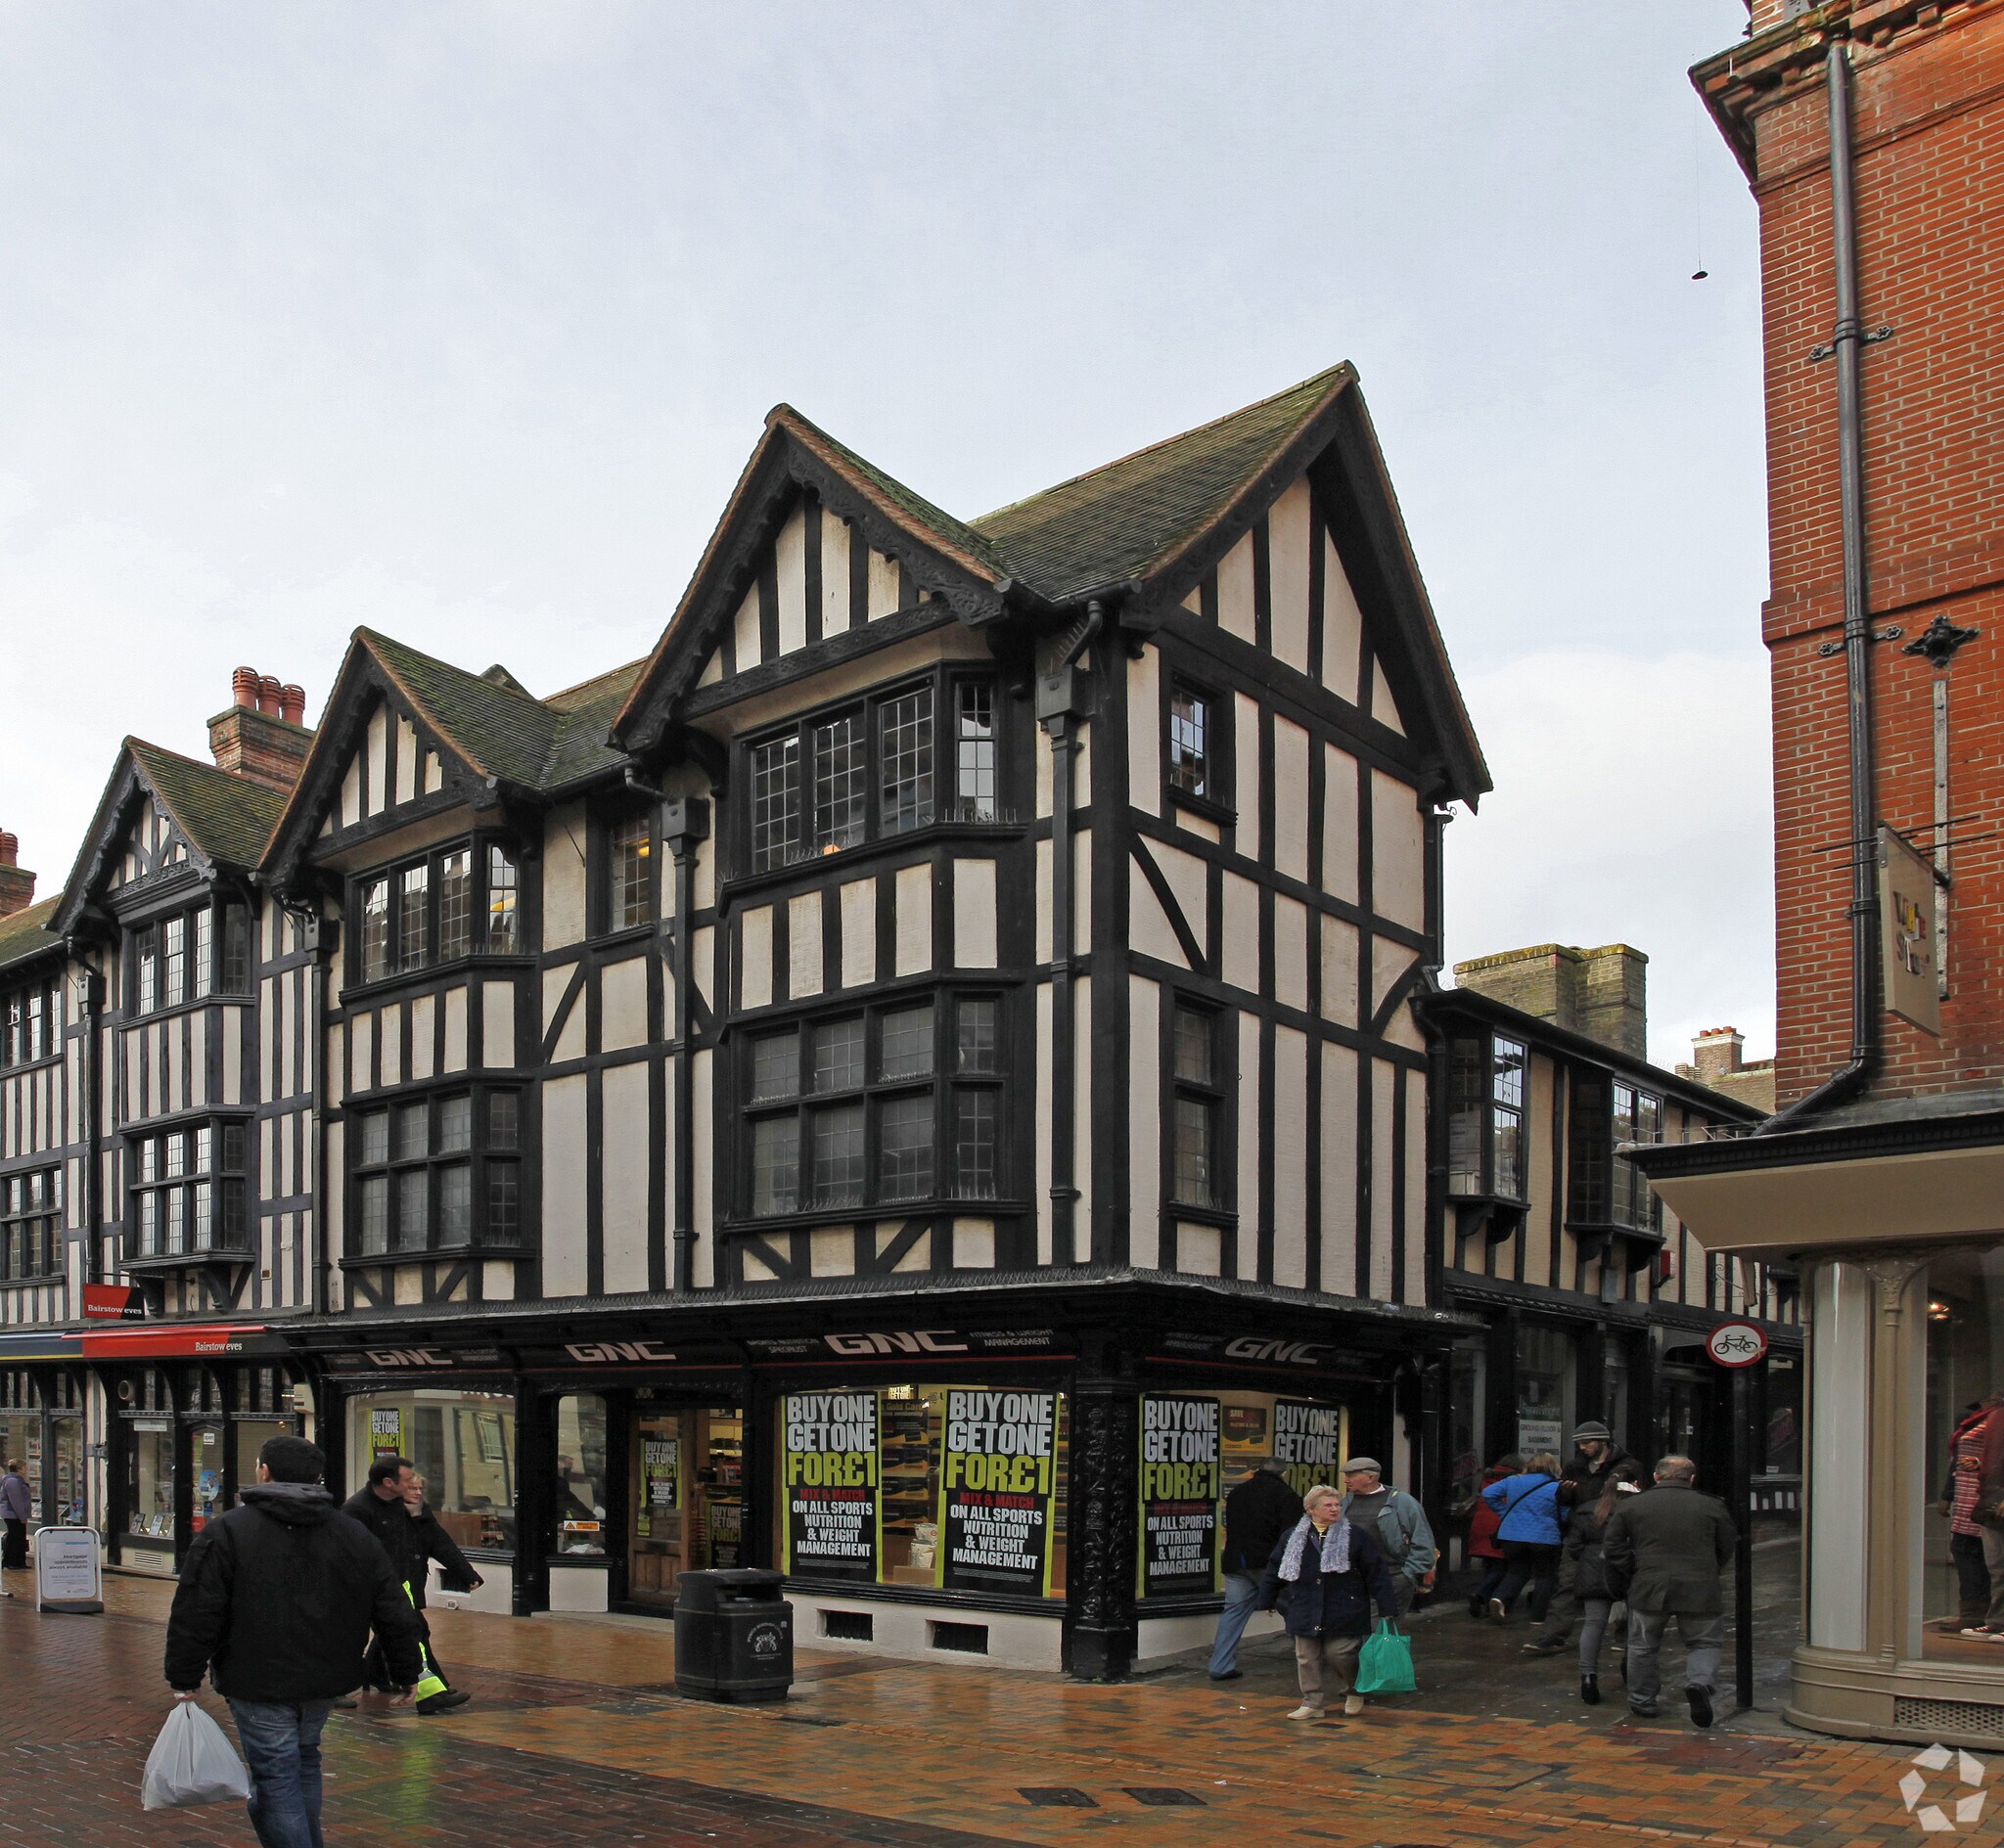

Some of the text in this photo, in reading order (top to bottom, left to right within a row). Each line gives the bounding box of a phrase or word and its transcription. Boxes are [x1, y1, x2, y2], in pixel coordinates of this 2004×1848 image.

[88, 1304, 123, 1313] Bairstow
[195, 1341, 243, 1352] Bairstow eves
[823, 1330, 968, 1355] GNC
[983, 1336, 1050, 1347] MANAGEMENT
[1225, 1335, 1336, 1365] GNC
[365, 1348, 453, 1367] GNC
[564, 1341, 677, 1362] GNC
[372, 1411, 399, 1422] BUY ONE
[787, 1395, 876, 1422] BUY ONE
[949, 1391, 1053, 1424] BUY ONE
[1145, 1399, 1218, 1431] BUY ONE
[372, 1422, 399, 1434] GET ONE
[1275, 1404, 1338, 1437] BUY ONE
[788, 1422, 876, 1452] GET ONE
[948, 1420, 1051, 1456] GET ONE
[1144, 1430, 1217, 1462] GET ONE
[646, 1442, 676, 1452] BUY ONE
[1303, 1436, 1338, 1465] ONE
[646, 1452, 676, 1464] GET ONE
[799, 1489, 865, 1501] MIX & MATCH
[959, 1492, 1034, 1510] MIX & MATCH
[711, 1506, 742, 1518] BUY ONE
[793, 1501, 873, 1515] ON ALL SPORTS
[950, 1505, 1043, 1525] ON ALL SPORTS
[804, 1514, 862, 1528] NUTRITION
[963, 1520, 1029, 1540] NUTRITION
[1147, 1515, 1213, 1531] ON ALL SPORTS
[807, 1528, 860, 1543] & WEIGHT
[965, 1534, 1025, 1554] & WEIGHT
[1156, 1530, 1204, 1546] NUTRITION
[797, 1541, 871, 1557] MANAGEMENT
[1159, 1544, 1201, 1559] & WEIGHT
[953, 1548, 1037, 1570] MANAGEMENT
[1149, 1557, 1209, 1575] MANAGEMENT
